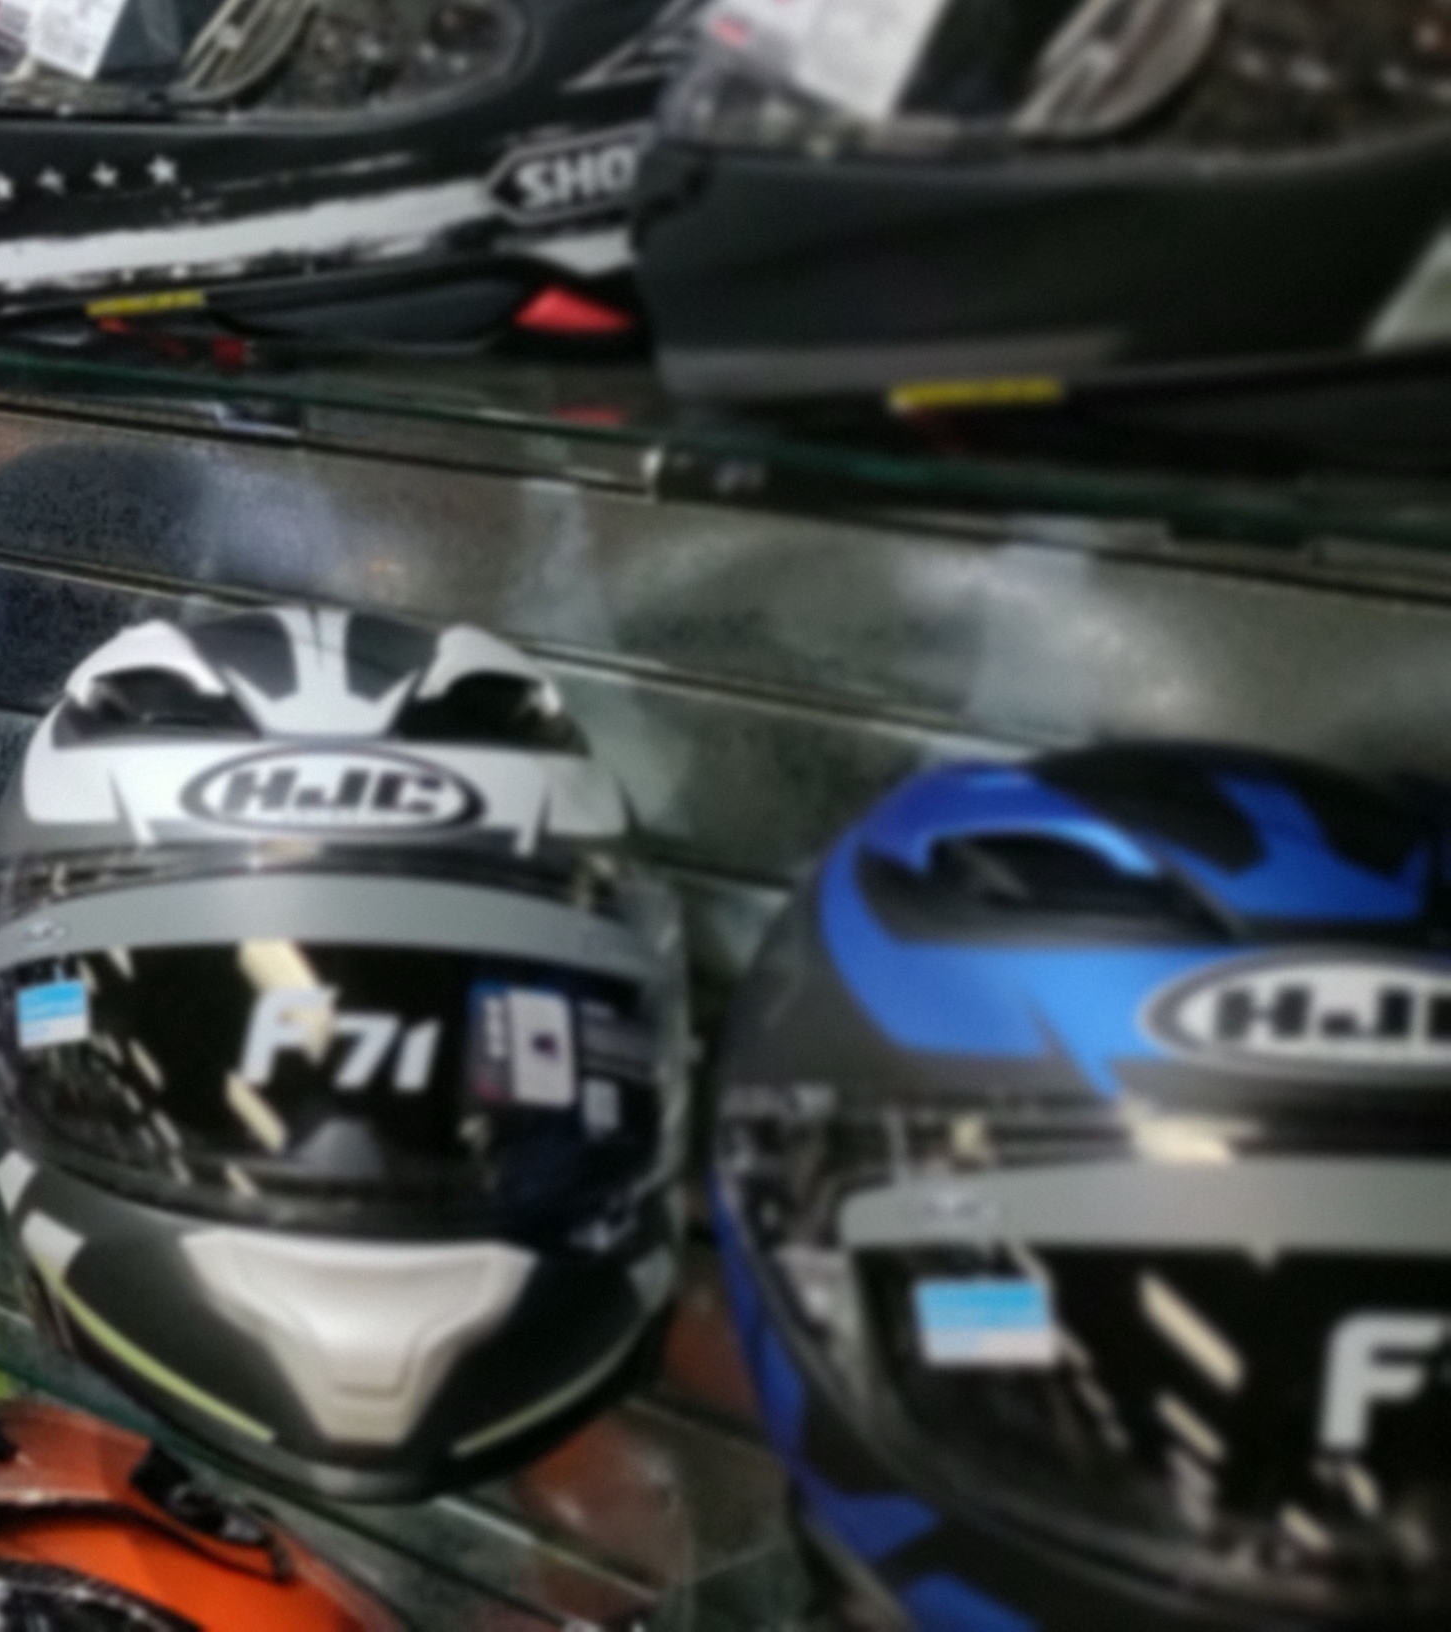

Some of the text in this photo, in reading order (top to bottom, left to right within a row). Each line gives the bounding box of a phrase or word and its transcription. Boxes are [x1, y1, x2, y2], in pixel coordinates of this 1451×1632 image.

[516, 146, 640, 210] SHO
[226, 771, 445, 819] HJC
[1214, 982, 1451, 1044] HJ
